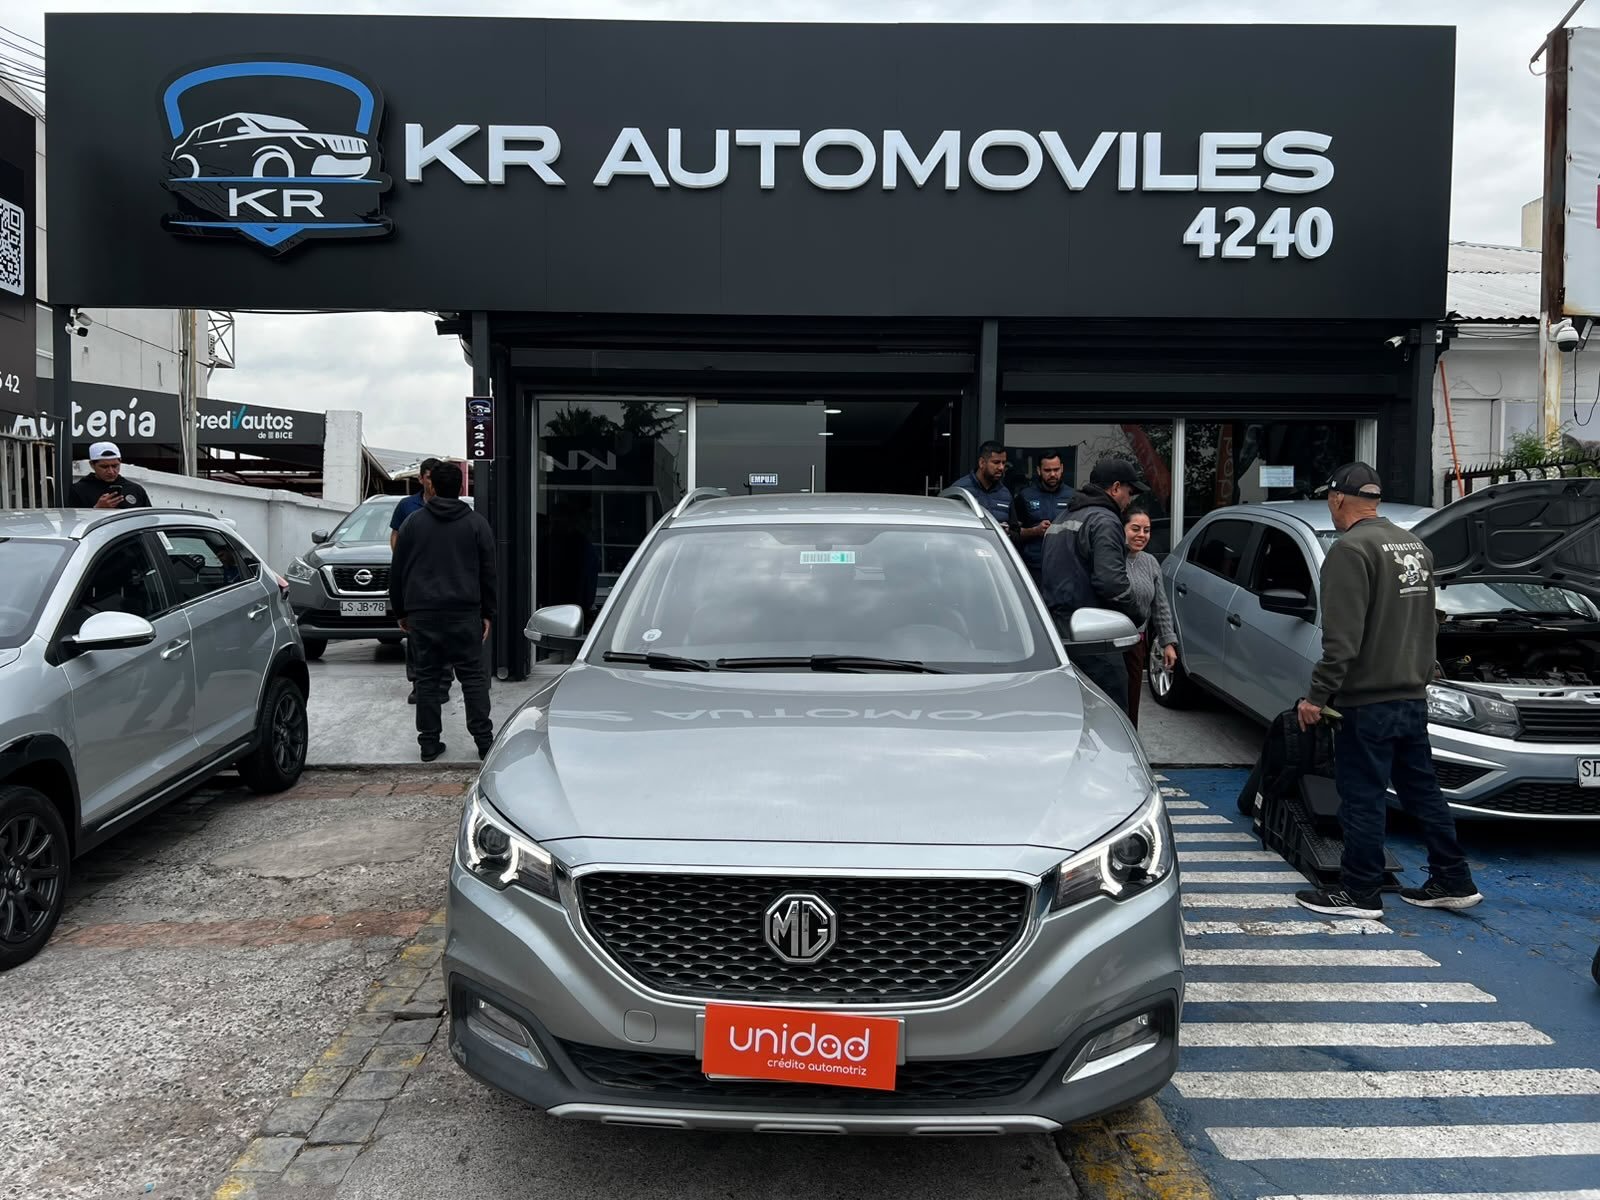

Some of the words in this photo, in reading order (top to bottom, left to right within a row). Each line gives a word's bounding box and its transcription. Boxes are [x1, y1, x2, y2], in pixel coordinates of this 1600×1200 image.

[405, 123, 567, 186] KR
[593, 127, 1335, 194] AUTOMOVILES
[228, 188, 325, 218] KR
[1183, 206, 1334, 259] 4240
[474, 423, 485, 456] 4240
[341, 602, 354, 612] LS
[772, 900, 828, 957] MG
[729, 1023, 870, 1062] unidad
[767, 1057, 805, 1071] crédito
[808, 1061, 867, 1076] automotriz
